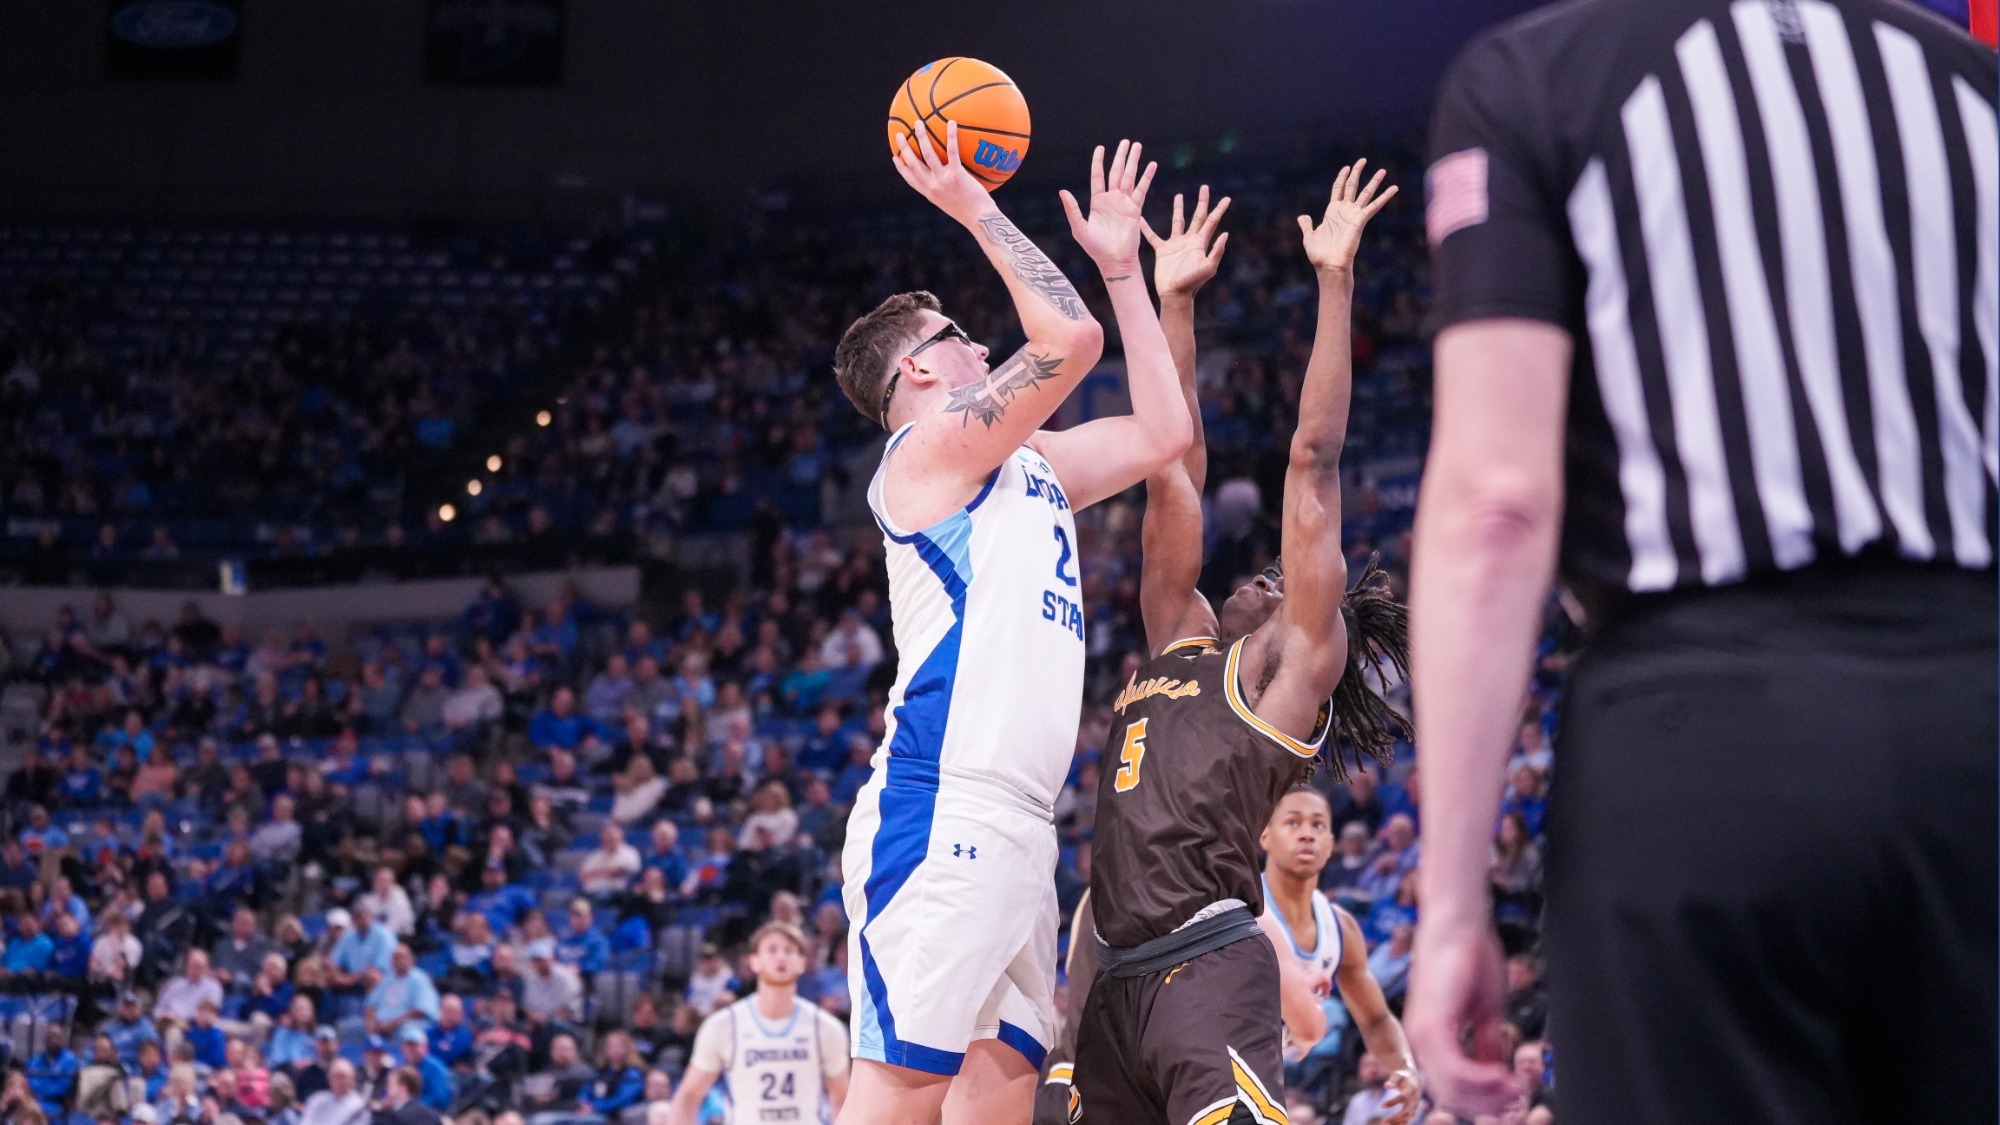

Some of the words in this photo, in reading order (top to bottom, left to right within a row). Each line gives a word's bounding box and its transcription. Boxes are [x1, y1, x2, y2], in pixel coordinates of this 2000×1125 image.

[1053, 524, 1077, 587] 2
[1114, 717, 1149, 793] 5
[760, 1072, 795, 1101] 24
